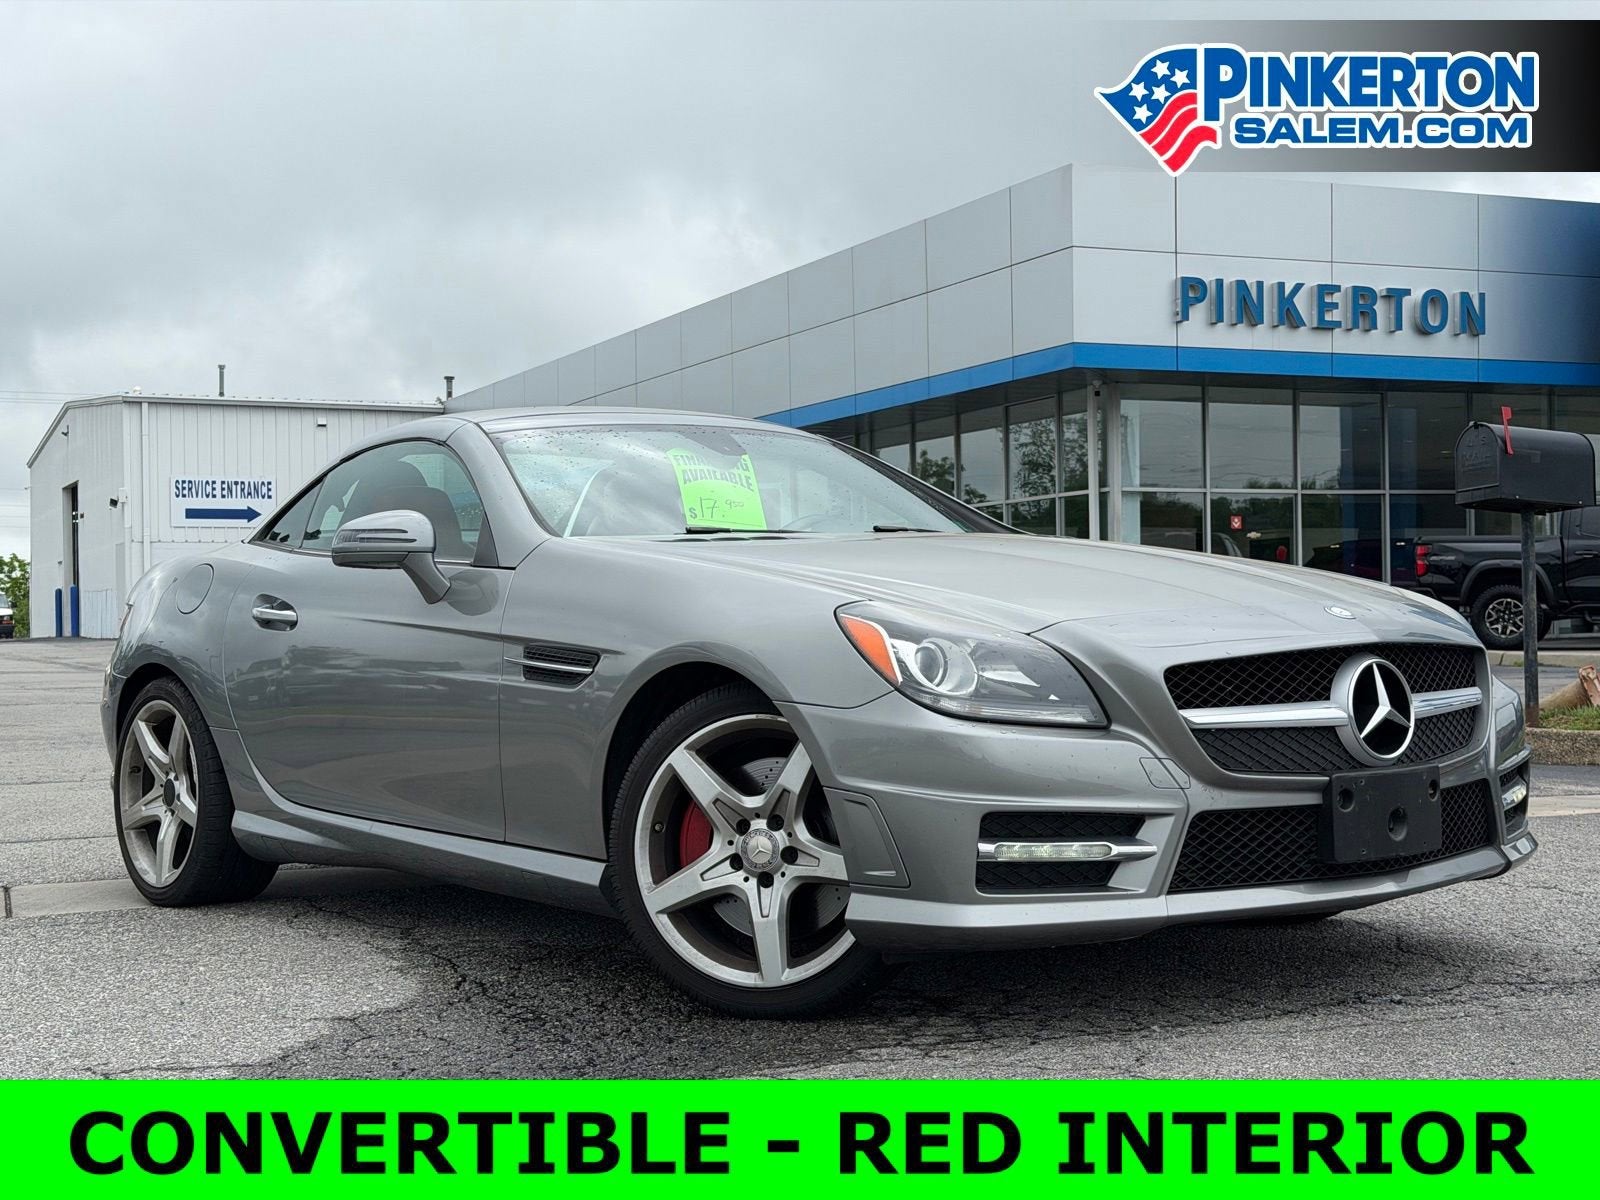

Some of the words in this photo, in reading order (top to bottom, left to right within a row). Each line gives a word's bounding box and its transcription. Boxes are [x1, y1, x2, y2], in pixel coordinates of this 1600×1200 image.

[1175, 276, 1487, 336] PINKERTON
[174, 479, 217, 499] SERVICE
[220, 480, 273, 500] ENTRANCE
[682, 468, 755, 493] AVAILABLE
